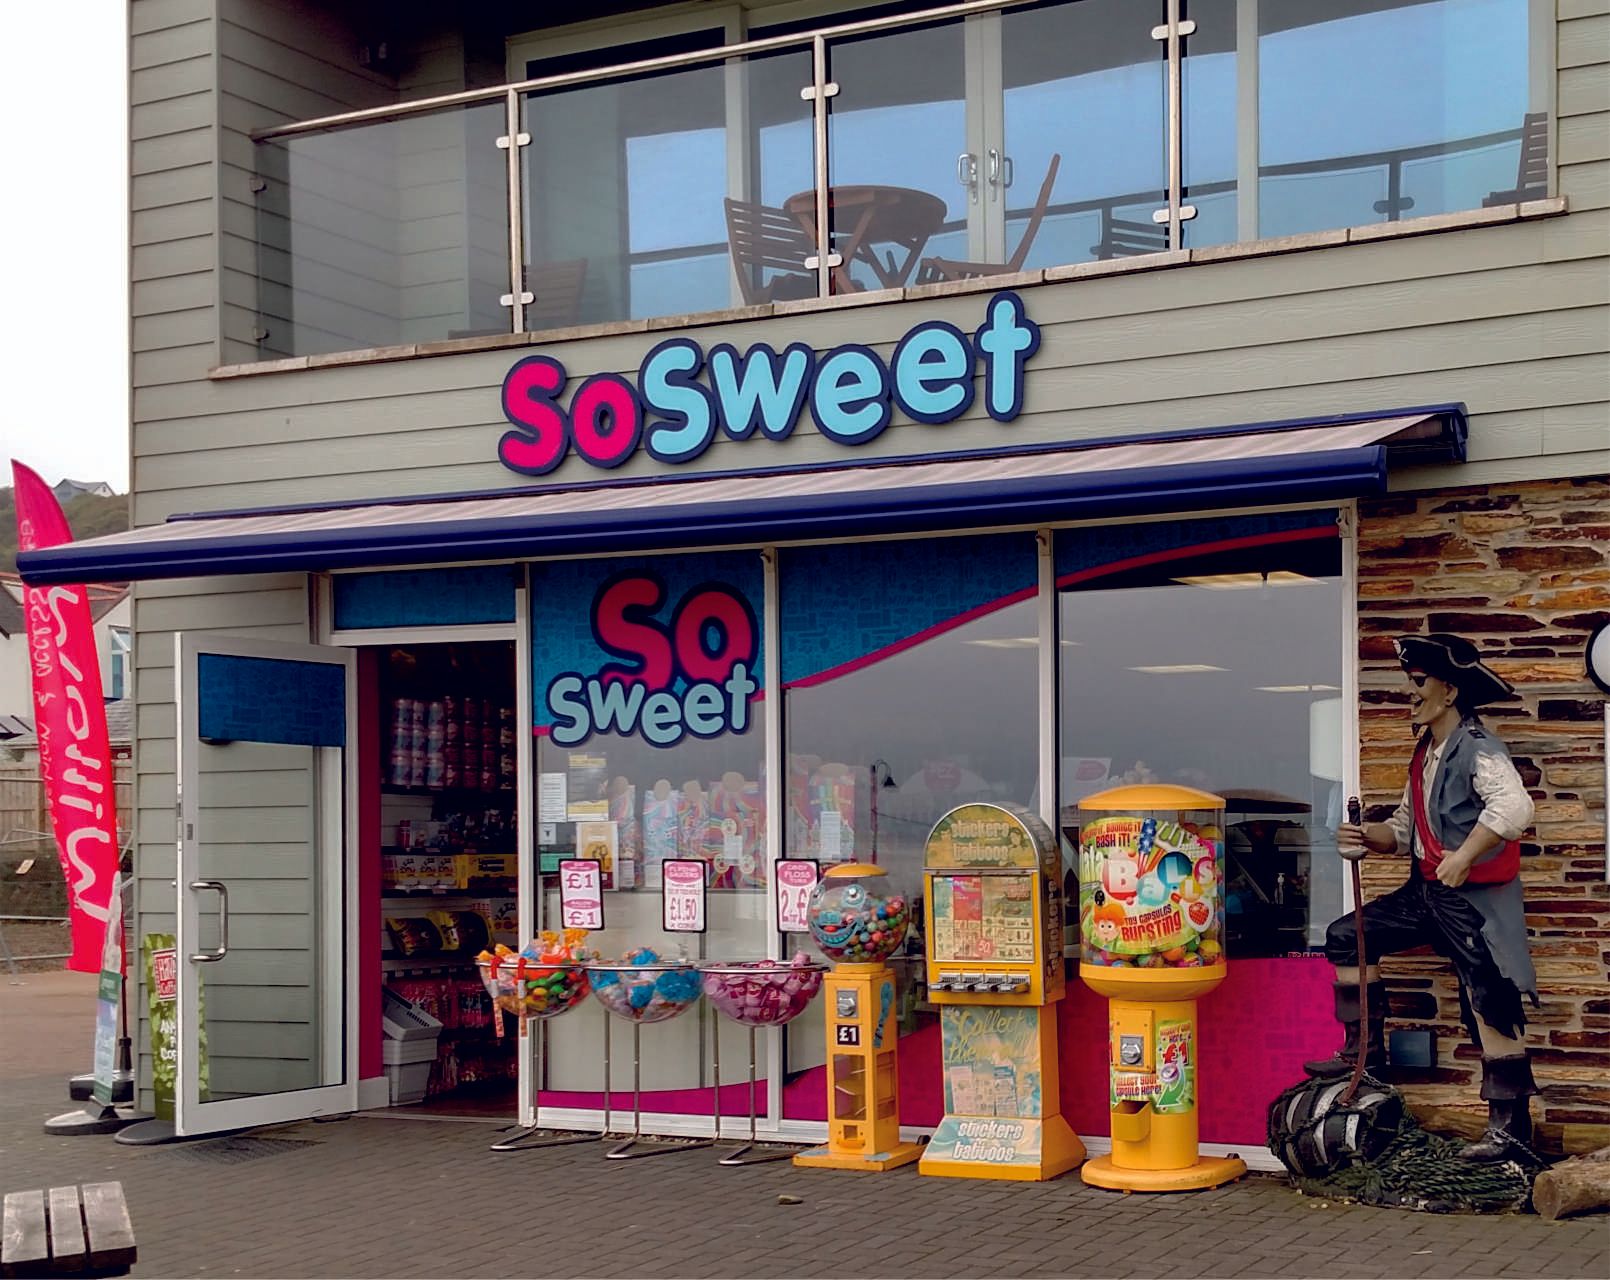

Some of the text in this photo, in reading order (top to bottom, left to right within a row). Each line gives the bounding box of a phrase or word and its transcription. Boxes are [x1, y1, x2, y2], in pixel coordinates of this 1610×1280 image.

[546, 660, 759, 747] Sweet
[566, 873, 593, 889] £1
[568, 911, 596, 926] £1
[838, 1026, 857, 1043] £1
[957, 1120, 1023, 1140] stickers
[952, 1140, 1015, 1162] tattoos
